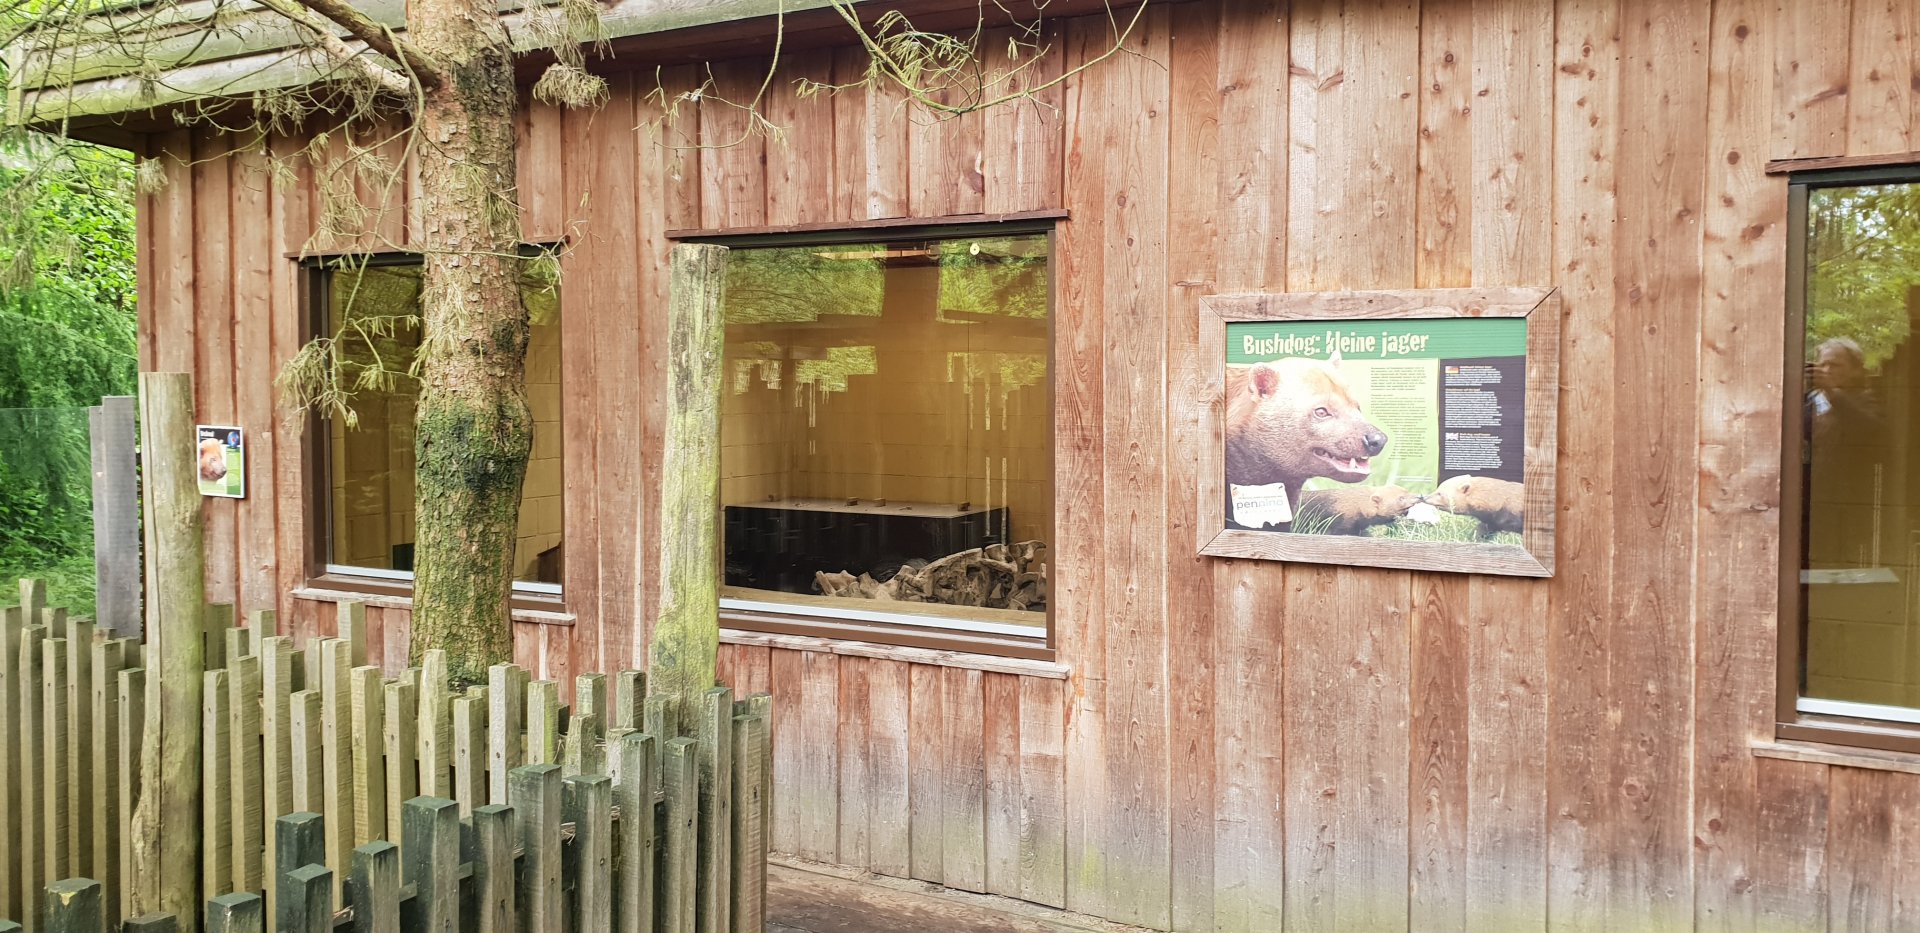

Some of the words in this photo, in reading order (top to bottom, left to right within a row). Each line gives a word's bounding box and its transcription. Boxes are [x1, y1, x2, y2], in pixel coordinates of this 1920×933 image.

[1243, 333, 1320, 356] Bushdog:
[1326, 330, 1376, 354] kleine
[1380, 331, 1429, 357] jager
